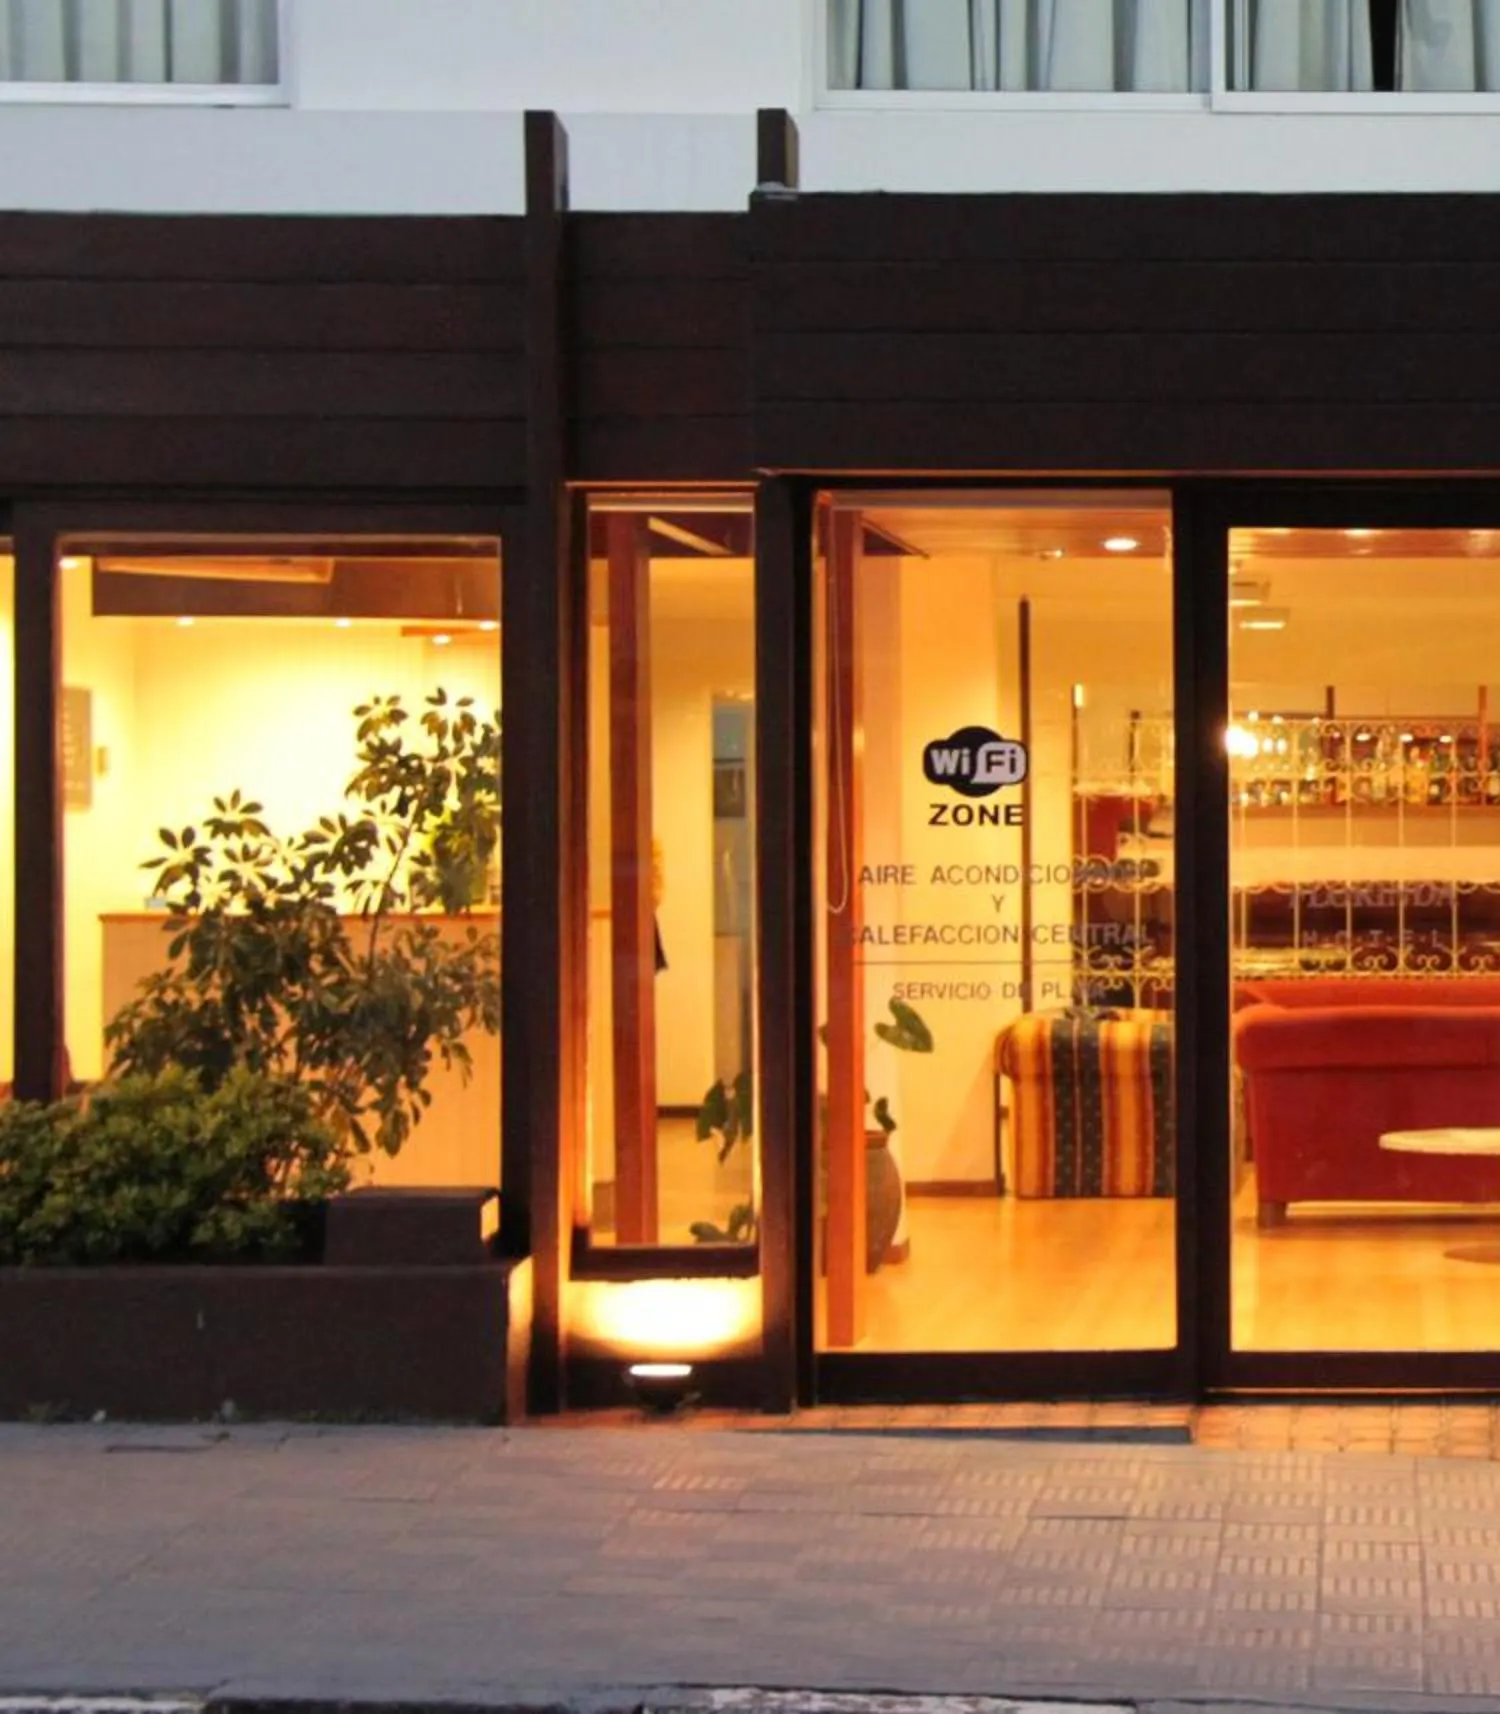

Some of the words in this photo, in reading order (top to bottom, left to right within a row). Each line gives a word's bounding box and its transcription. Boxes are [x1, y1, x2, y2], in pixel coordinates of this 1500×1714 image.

[928, 804, 1024, 827] ZONE
[858, 864, 916, 886] AIRE
[992, 894, 1005, 914] Y
[847, 924, 1019, 946] ALEFACCION
[893, 981, 991, 1000] SERVICIO
